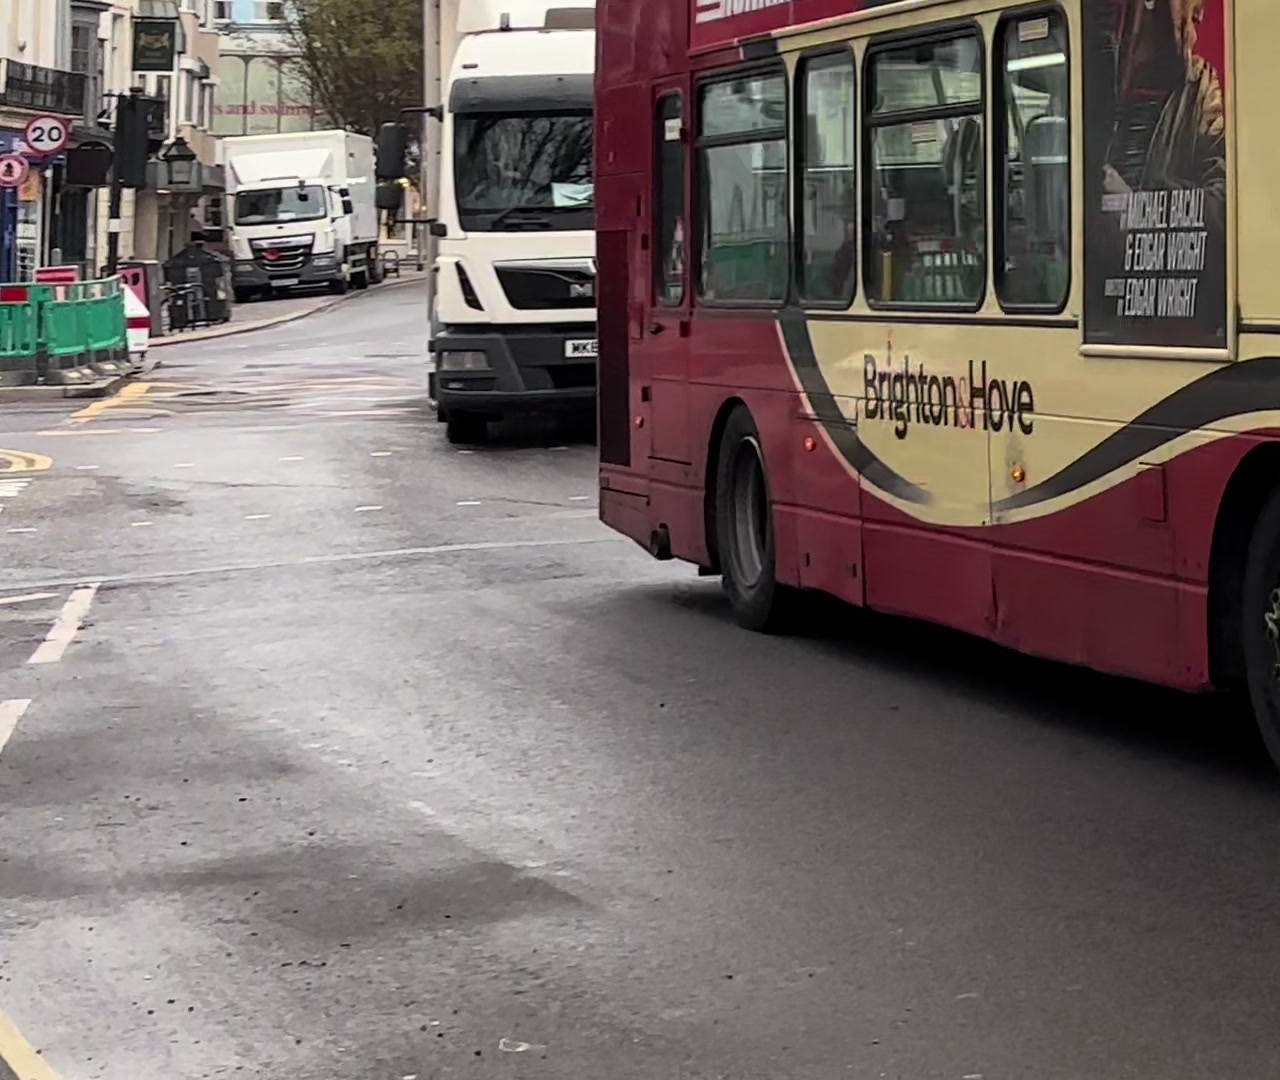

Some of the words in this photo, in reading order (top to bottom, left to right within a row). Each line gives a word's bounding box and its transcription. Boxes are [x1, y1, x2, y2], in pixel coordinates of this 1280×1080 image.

[32, 126, 62, 142] 20
[1127, 191, 1168, 229] MICHAEL
[1170, 188, 1204, 228] BACALL
[1133, 232, 1166, 271] EDGAR
[1167, 231, 1208, 271] WRIGHT
[1125, 278, 1157, 316] EDGAR
[1157, 277, 1198, 317] WRIGHT
